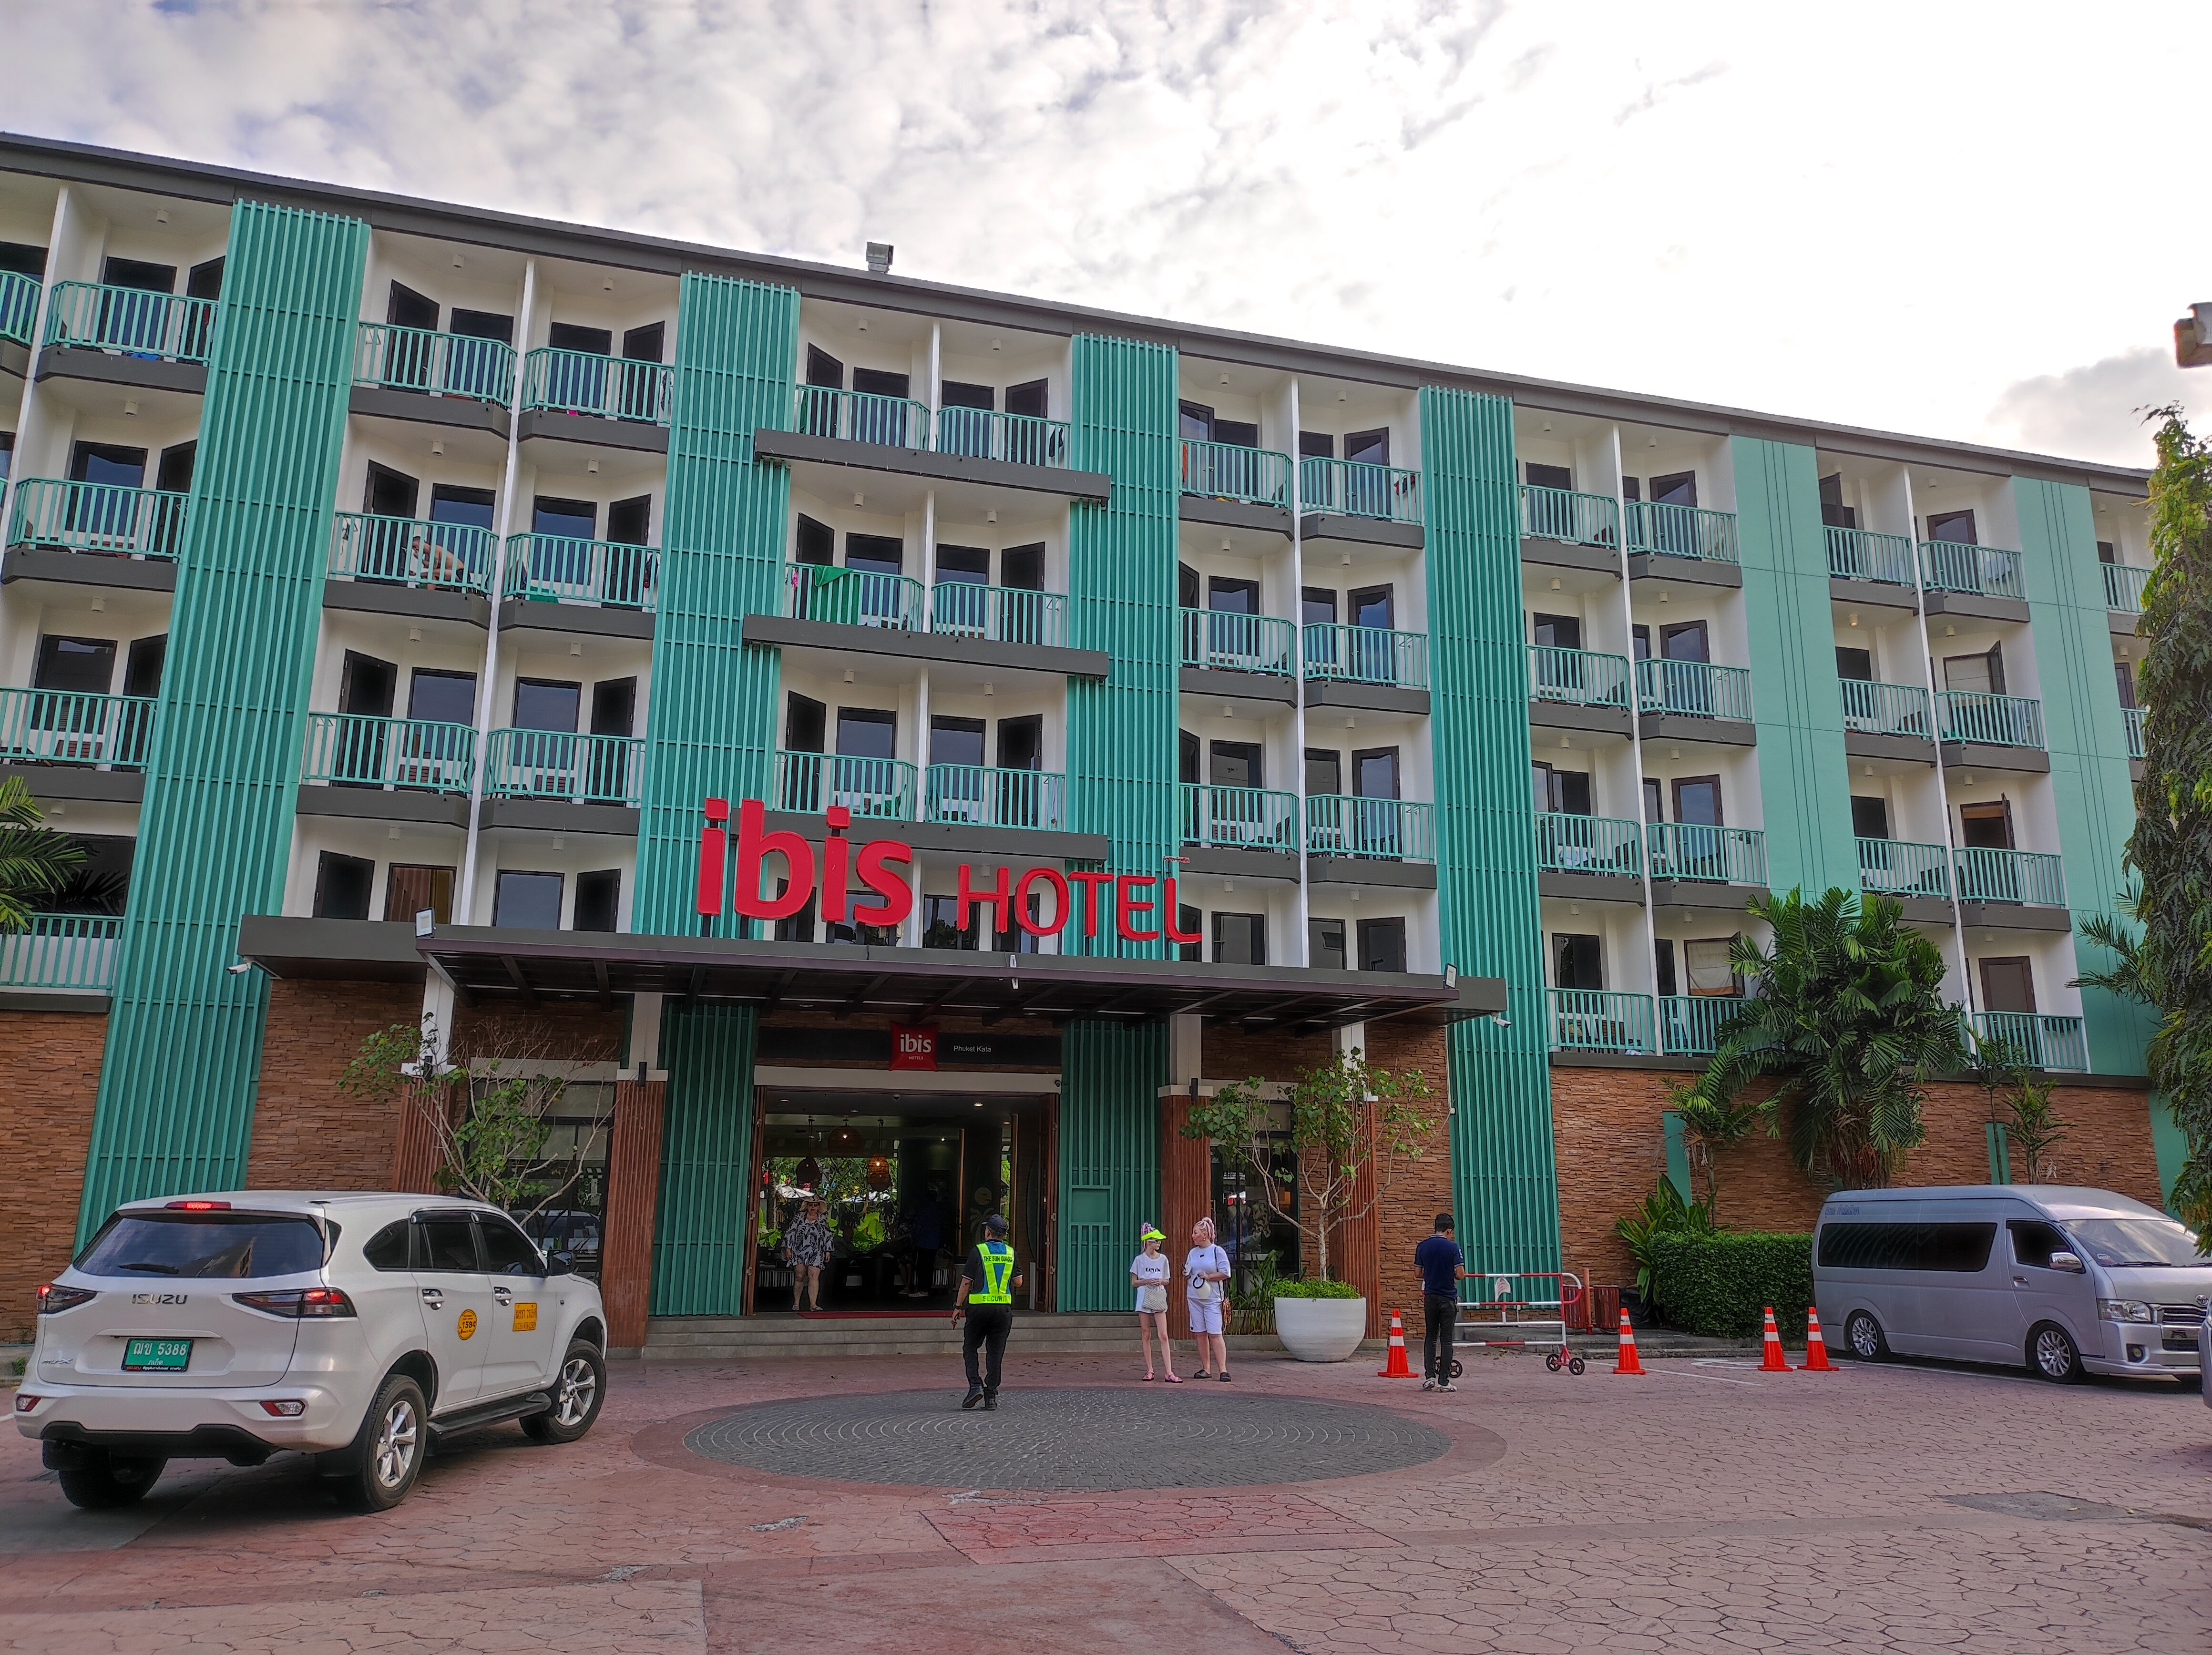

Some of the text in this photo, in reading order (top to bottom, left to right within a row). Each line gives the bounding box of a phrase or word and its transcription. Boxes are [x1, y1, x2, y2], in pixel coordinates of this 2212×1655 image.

[696, 797, 1203, 944] ibis HOTEL
[900, 1033, 932, 1053] ibis
[132, 1294, 188, 1304] ISUZU
[461, 1320, 476, 1329] 1584
[157, 1343, 187, 1356] 5388
[147, 1358, 164, 1366] ภเก็ต
